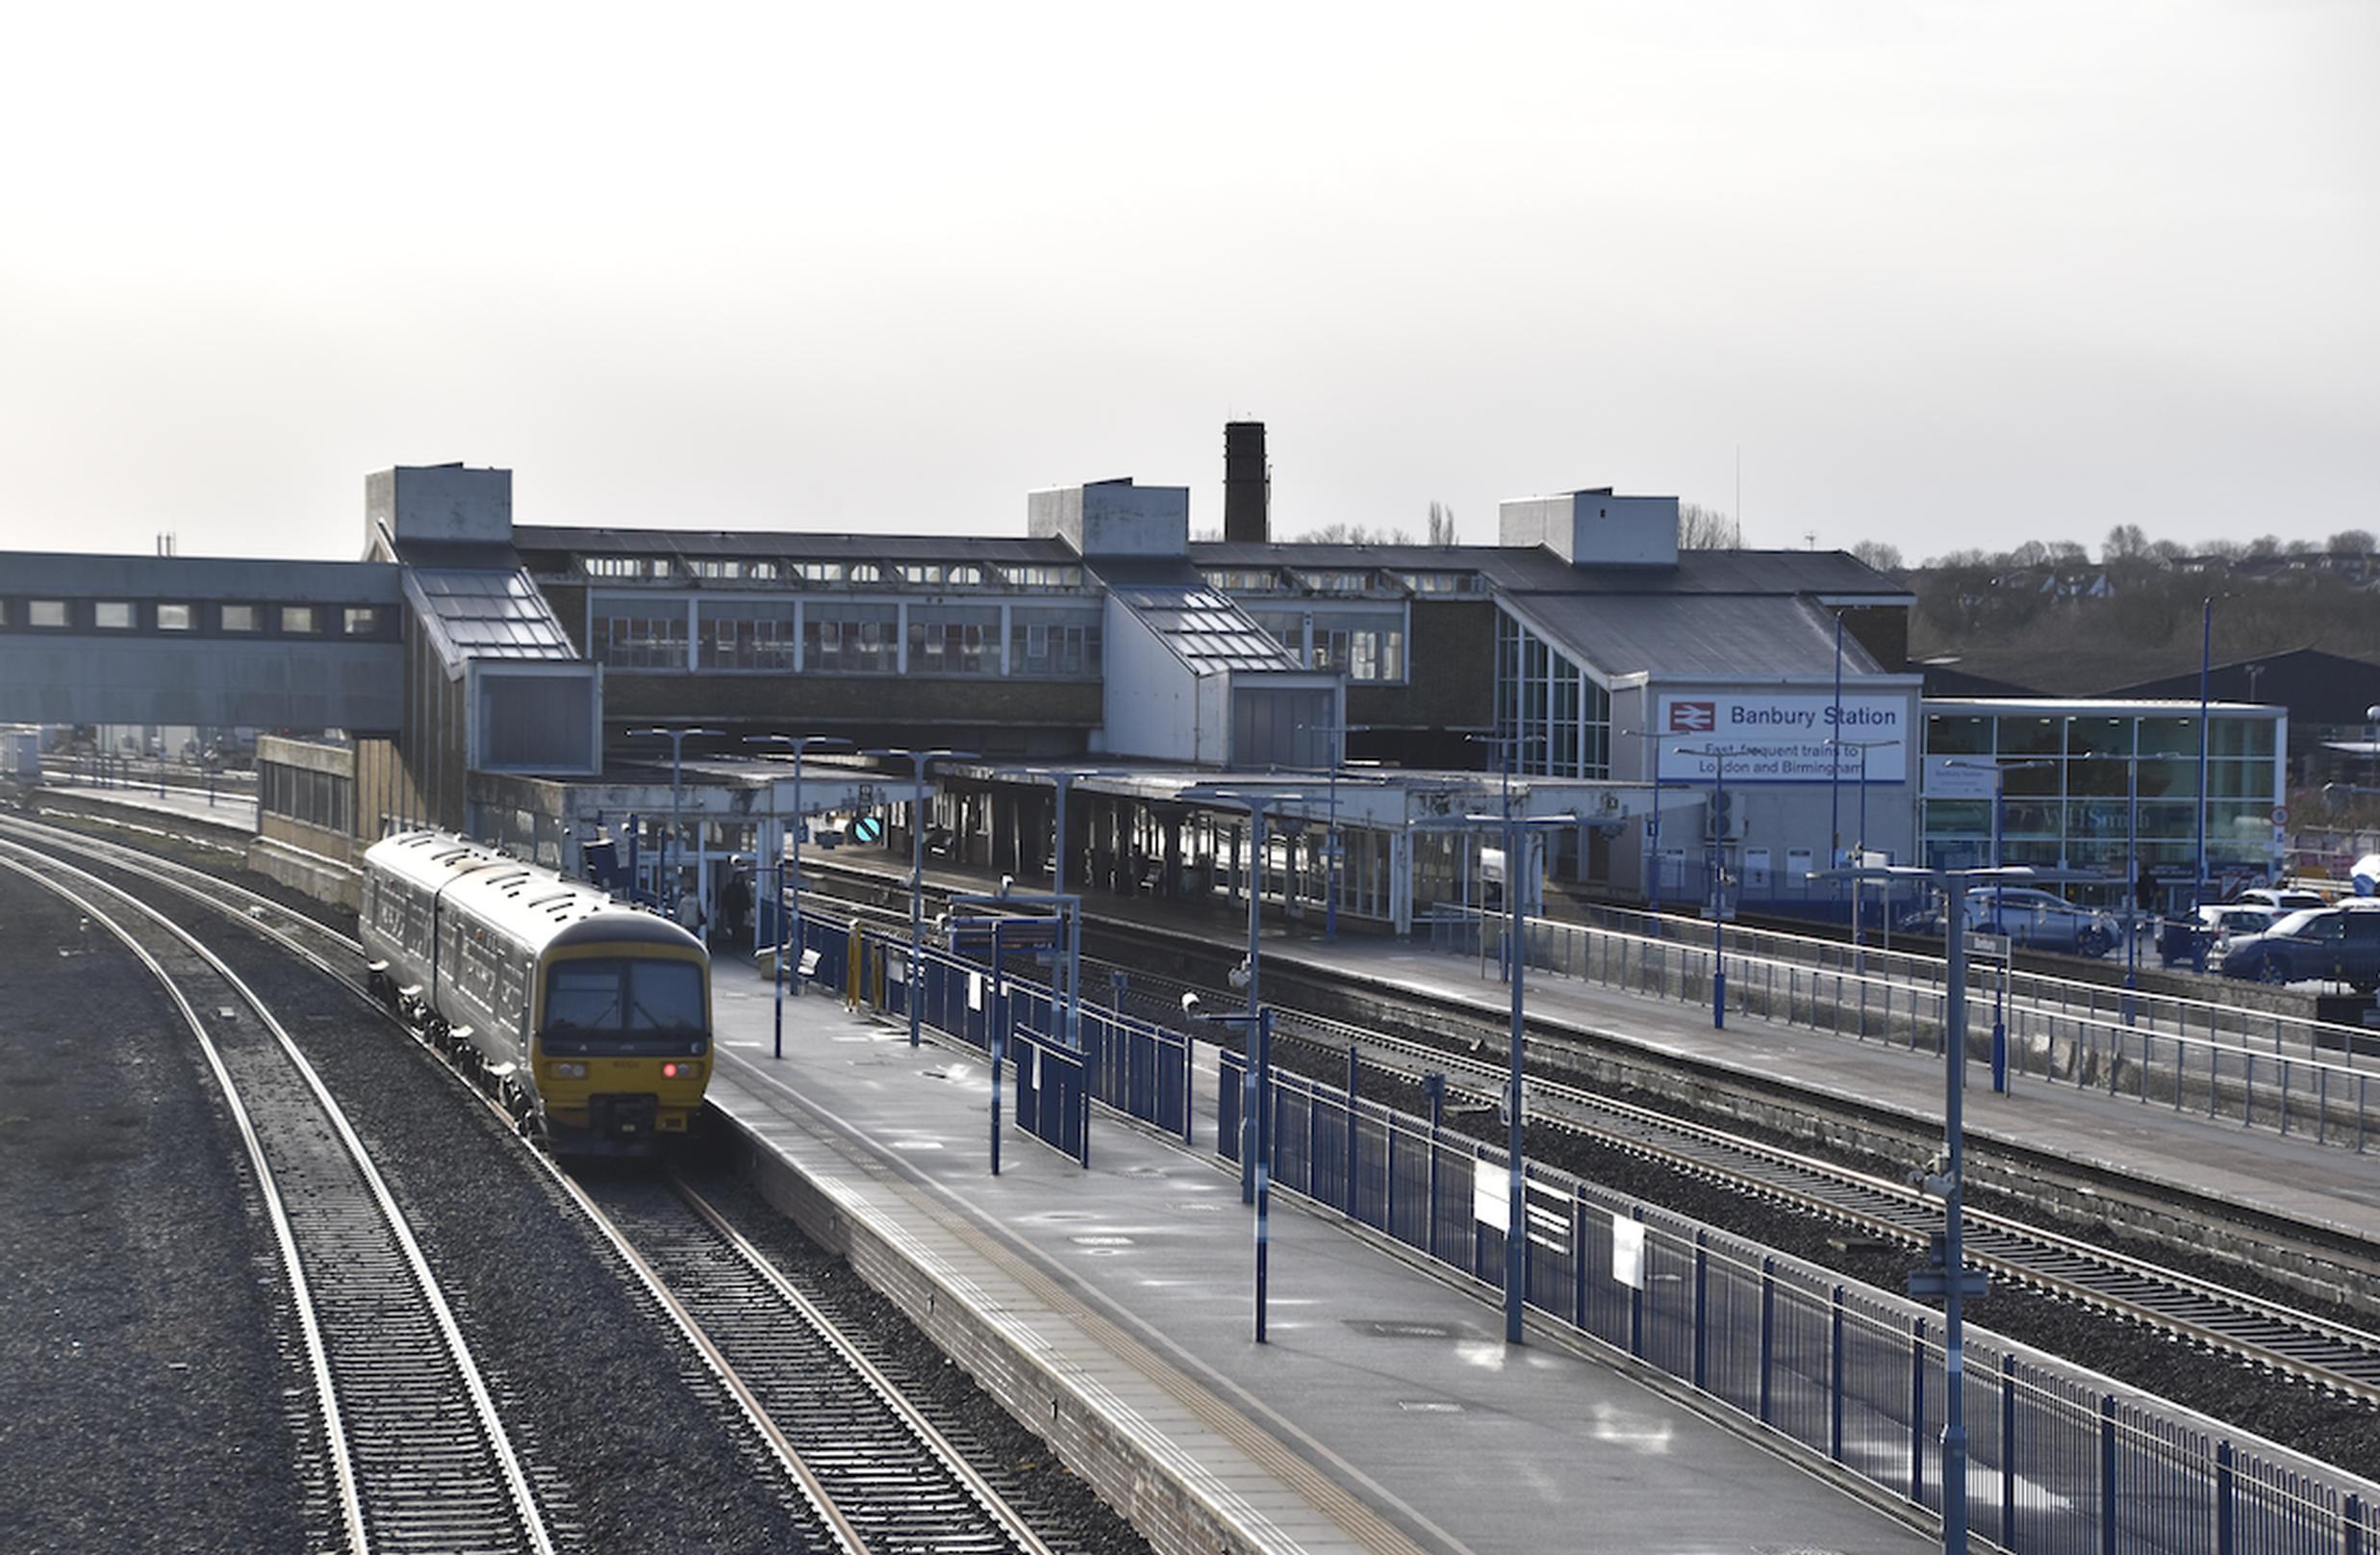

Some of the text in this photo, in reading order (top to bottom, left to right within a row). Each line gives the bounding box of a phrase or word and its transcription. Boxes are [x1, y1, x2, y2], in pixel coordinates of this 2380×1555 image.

[1731, 705, 1896, 728] Banbury Station
[1741, 743, 1799, 759] frequent
[1843, 745, 1859, 757] to
[1699, 760, 1750, 773] Lodon
[1754, 761, 1778, 774] and
